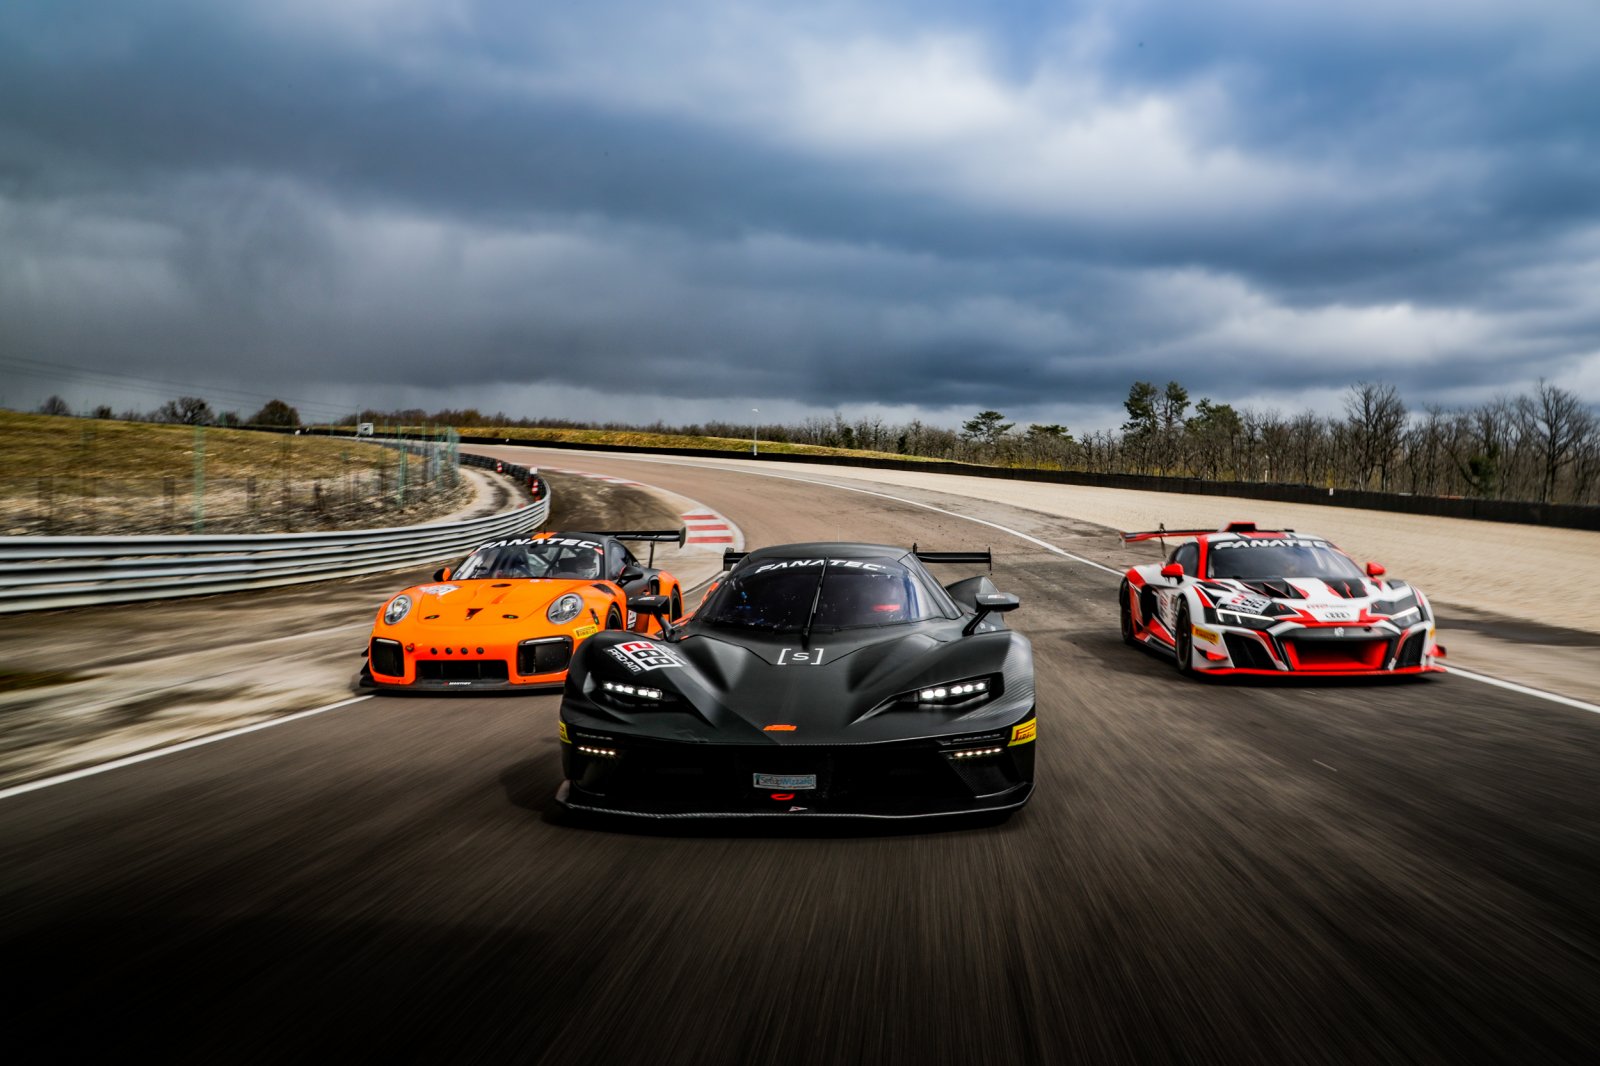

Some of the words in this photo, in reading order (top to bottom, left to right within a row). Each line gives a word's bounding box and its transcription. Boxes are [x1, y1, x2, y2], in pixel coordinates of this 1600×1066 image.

[479, 538, 598, 549] FANATEC
[1214, 539, 1332, 550] FANATEC
[755, 560, 881, 574] FANATEC
[622, 643, 676, 666] 289
